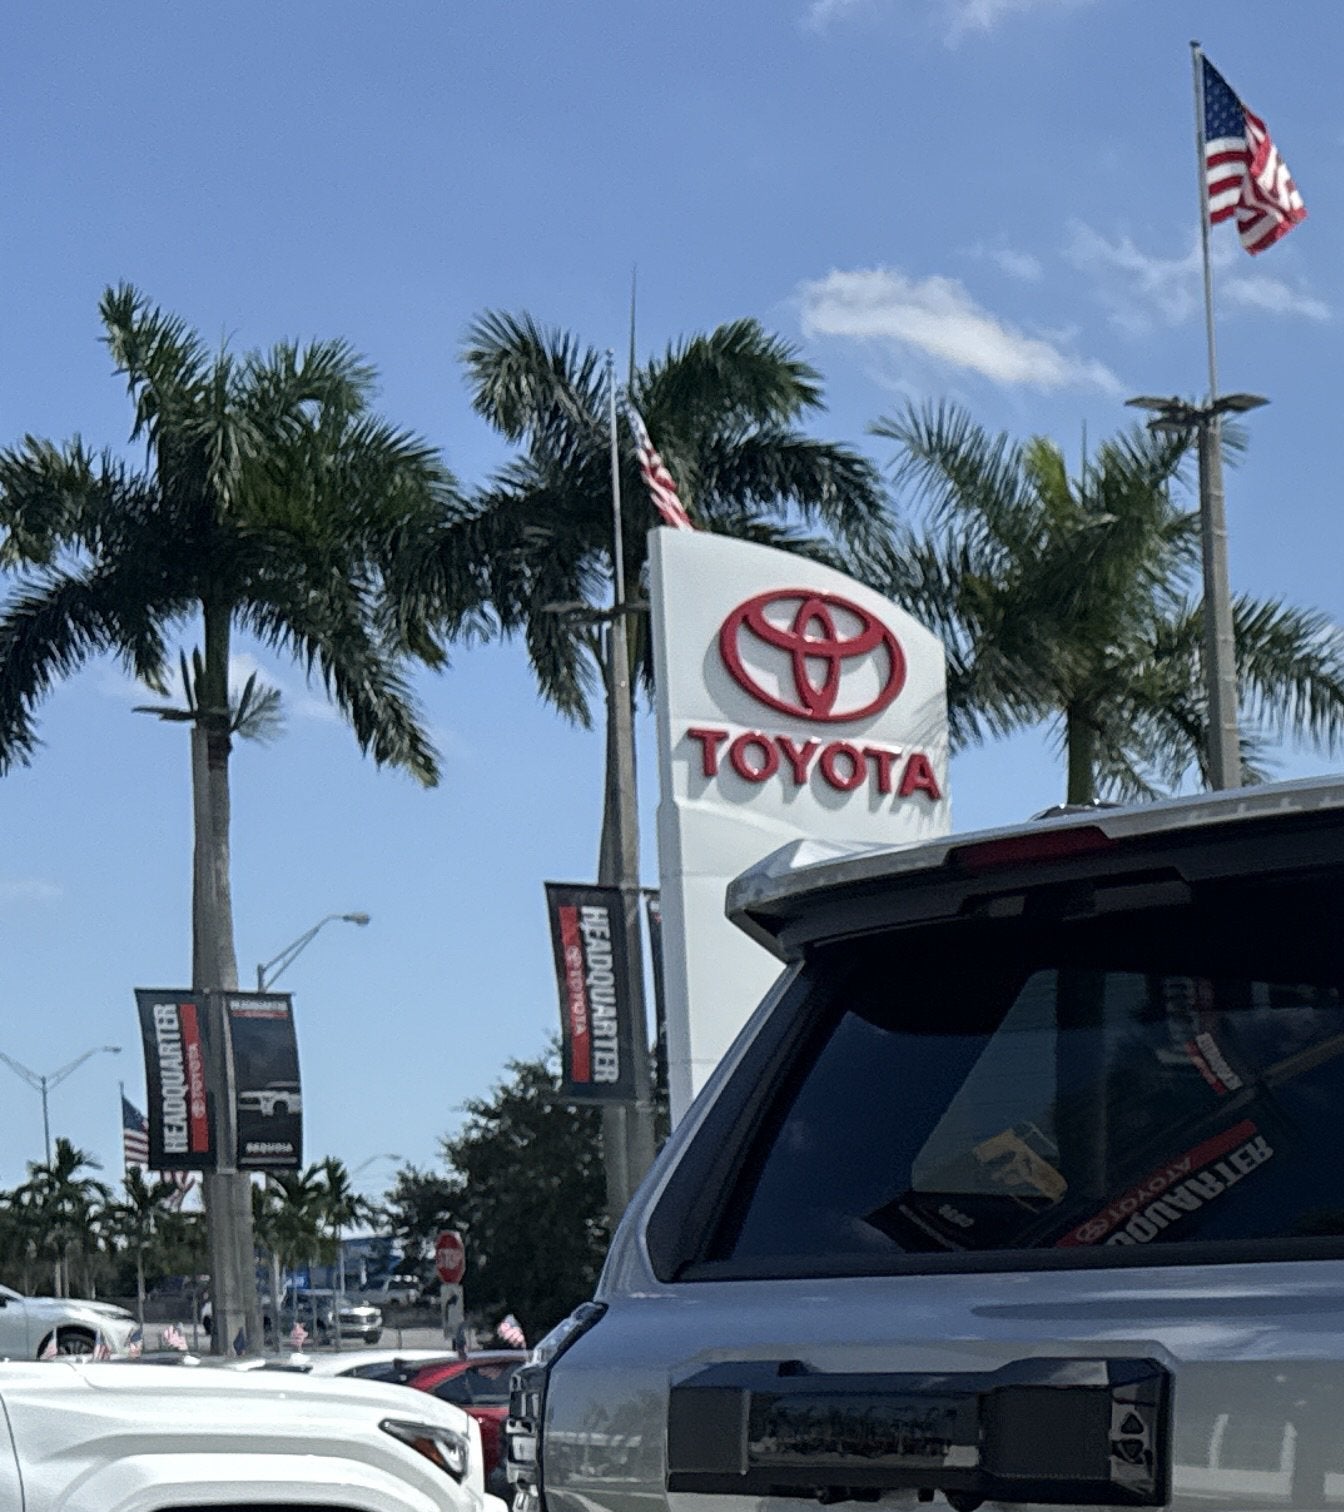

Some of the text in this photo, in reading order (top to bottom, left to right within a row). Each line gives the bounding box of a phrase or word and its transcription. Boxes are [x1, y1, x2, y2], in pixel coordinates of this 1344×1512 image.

[687, 727, 942, 800] TOYOTA
[580, 905, 620, 1083] HEADQUARTER
[153, 1003, 189, 1153] HEADQUARTER
